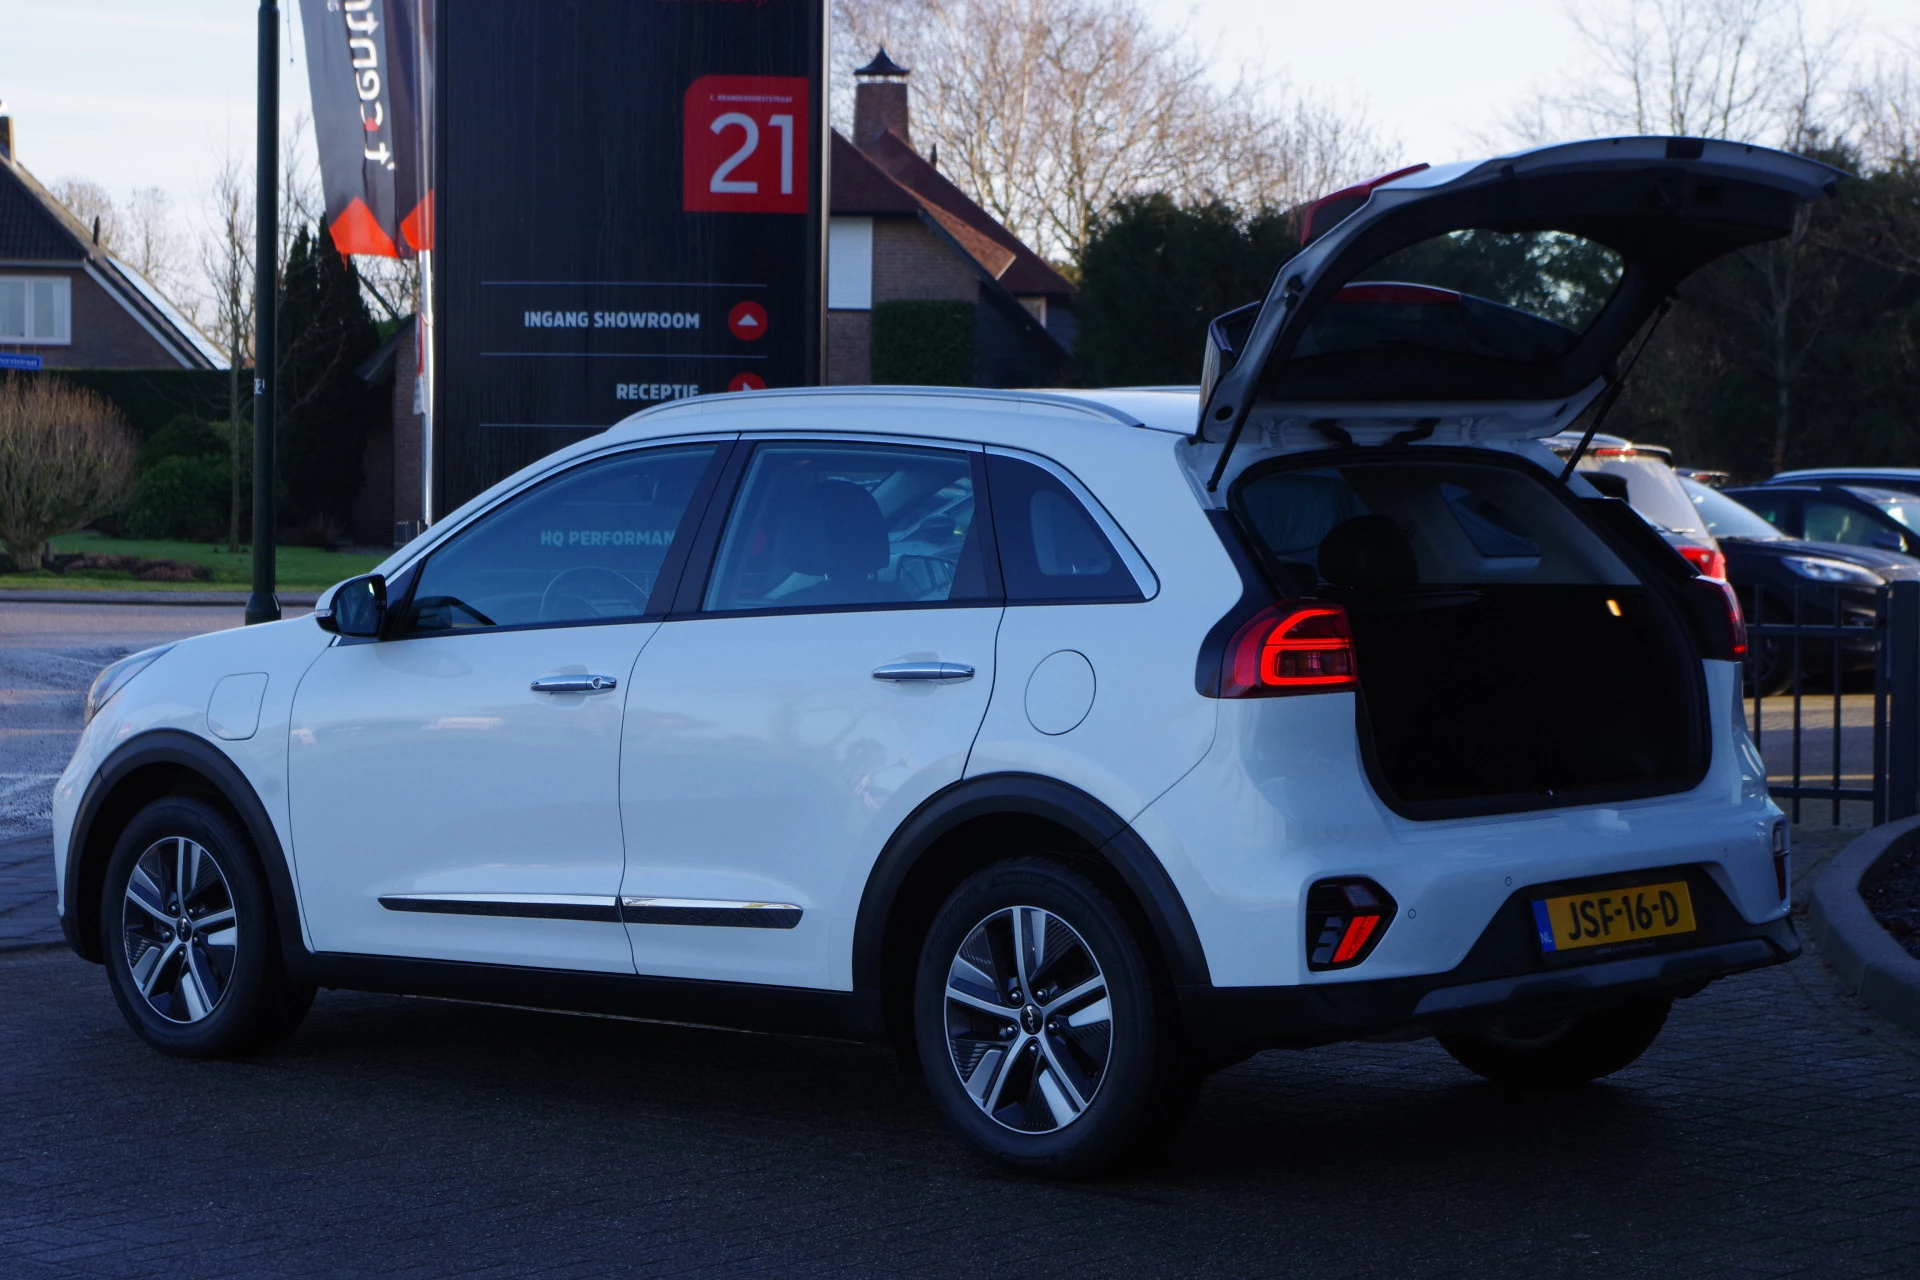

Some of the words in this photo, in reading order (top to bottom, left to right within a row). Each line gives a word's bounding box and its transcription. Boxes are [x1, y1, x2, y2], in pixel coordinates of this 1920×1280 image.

[709, 111, 794, 195] 21
[523, 311, 589, 328] INGANG
[593, 311, 701, 329] SHOWROOM
[616, 383, 699, 400] RECEPTIE
[540, 530, 564, 548] HQ
[1568, 889, 1679, 941] JSF-16-D
[1539, 931, 1553, 944] NL
